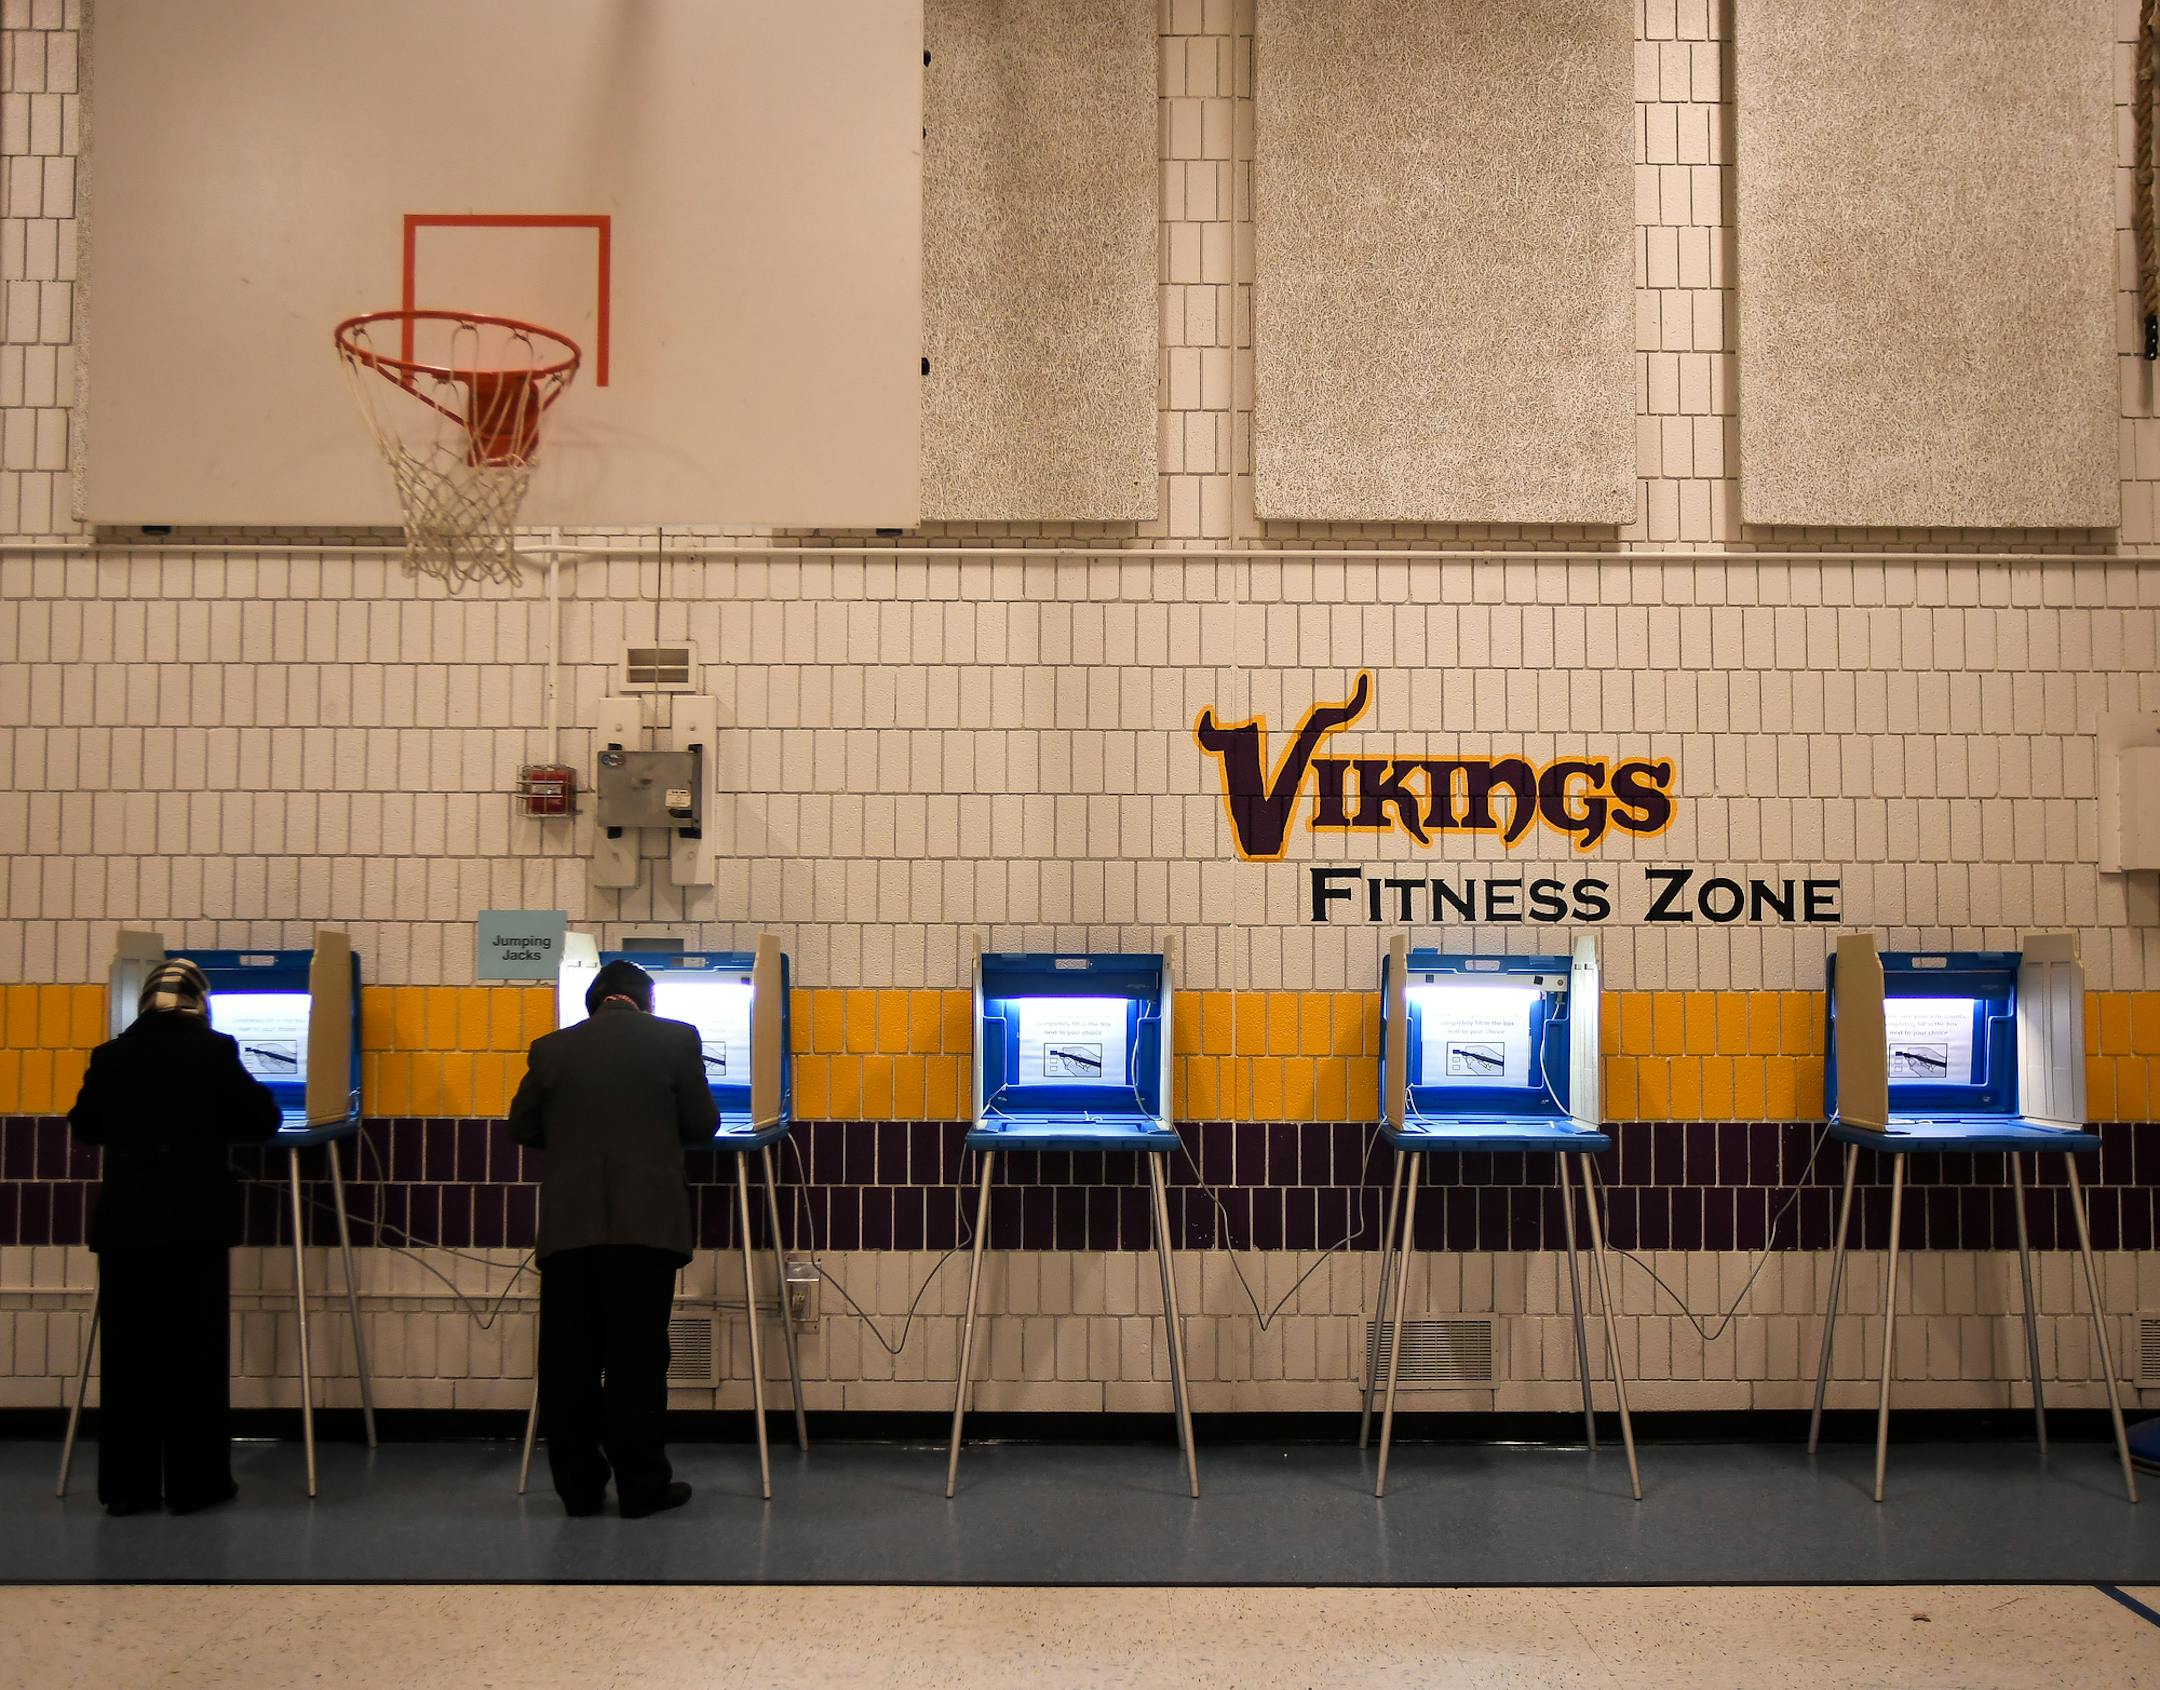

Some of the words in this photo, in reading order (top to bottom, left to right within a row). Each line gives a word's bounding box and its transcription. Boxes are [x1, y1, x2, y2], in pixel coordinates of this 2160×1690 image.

[1193, 668, 1677, 862] VIKINGS
[1310, 866, 1610, 923] FITNESS
[1644, 866, 1841, 923] ZONE
[492, 935, 551, 949] Jumping
[502, 950, 541, 960] Jacks
